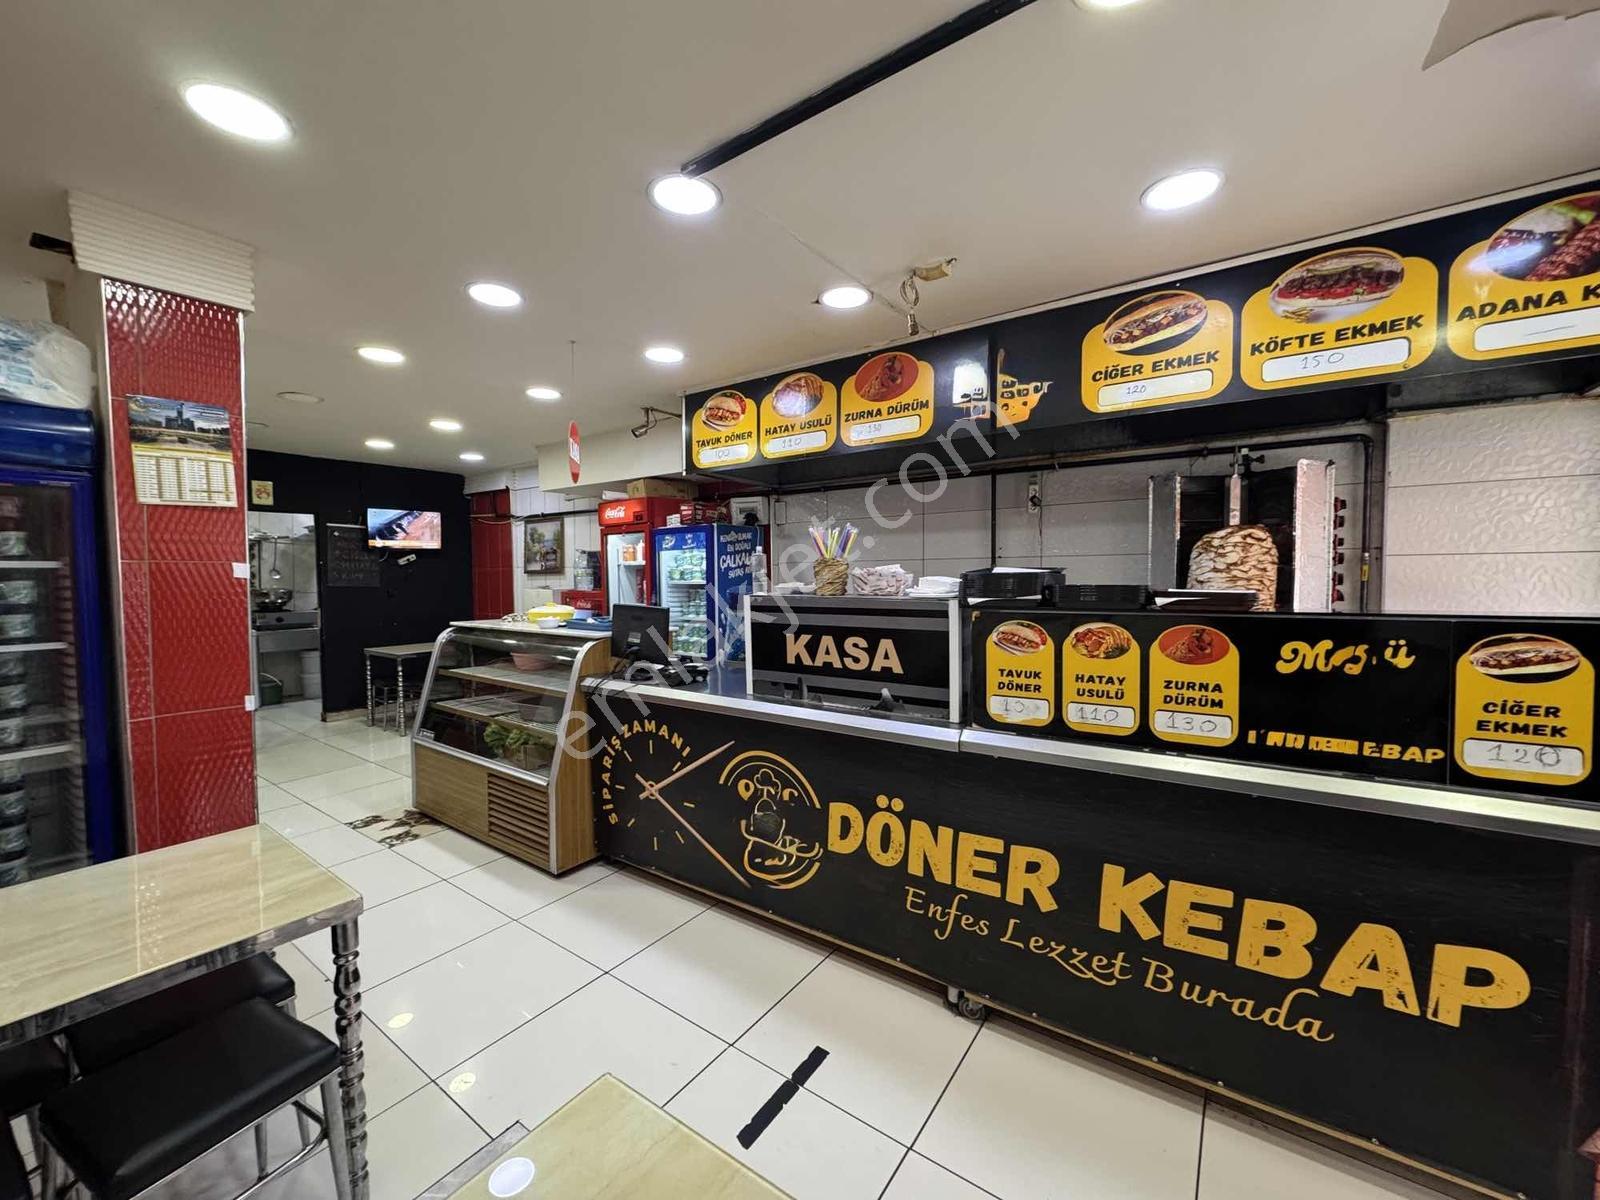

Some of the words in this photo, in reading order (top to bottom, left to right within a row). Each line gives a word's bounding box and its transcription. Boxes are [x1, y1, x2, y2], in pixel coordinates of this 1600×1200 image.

[1456, 290, 1568, 321] ADANA
[1250, 332, 1325, 356] KÖFTE
[1334, 314, 1424, 343] EKMEK
[1092, 361, 1144, 383] CİĞER
[1152, 350, 1219, 375] EKMEK
[1300, 352, 1344, 370] 150
[1126, 384, 1147, 395] 120
[845, 408, 882, 423] ZURNA
[887, 399, 929, 416] DÜRÜM
[765, 424, 796, 436] HATAY
[800, 415, 832, 430] USULÜ
[696, 437, 722, 448] TAVUK
[725, 431, 753, 443] DÖNER
[786, 634, 904, 674] KASA
[998, 668, 1042, 680] TAVUK
[1075, 674, 1126, 686] HATAY
[998, 680, 1042, 693] DÖNER
[1076, 688, 1125, 700] USULÜ
[1163, 680, 1223, 694] ZURNA
[1163, 695, 1224, 709] DÜRÜM
[1483, 700, 1561, 719] CİĞER
[1077, 706, 1119, 722] 110
[1166, 712, 1217, 733] 130
[621, 719, 691, 758] ZAMANI
[1476, 719, 1568, 738] EKMEK
[1487, 744, 1561, 767] 120
[827, 794, 1061, 913] DÖNER
[1098, 863, 1531, 1028] KEBAP
[905, 885, 990, 940] Enfes
[1000, 919, 1132, 985] Lezzet
[1143, 955, 1334, 1043] Burada
